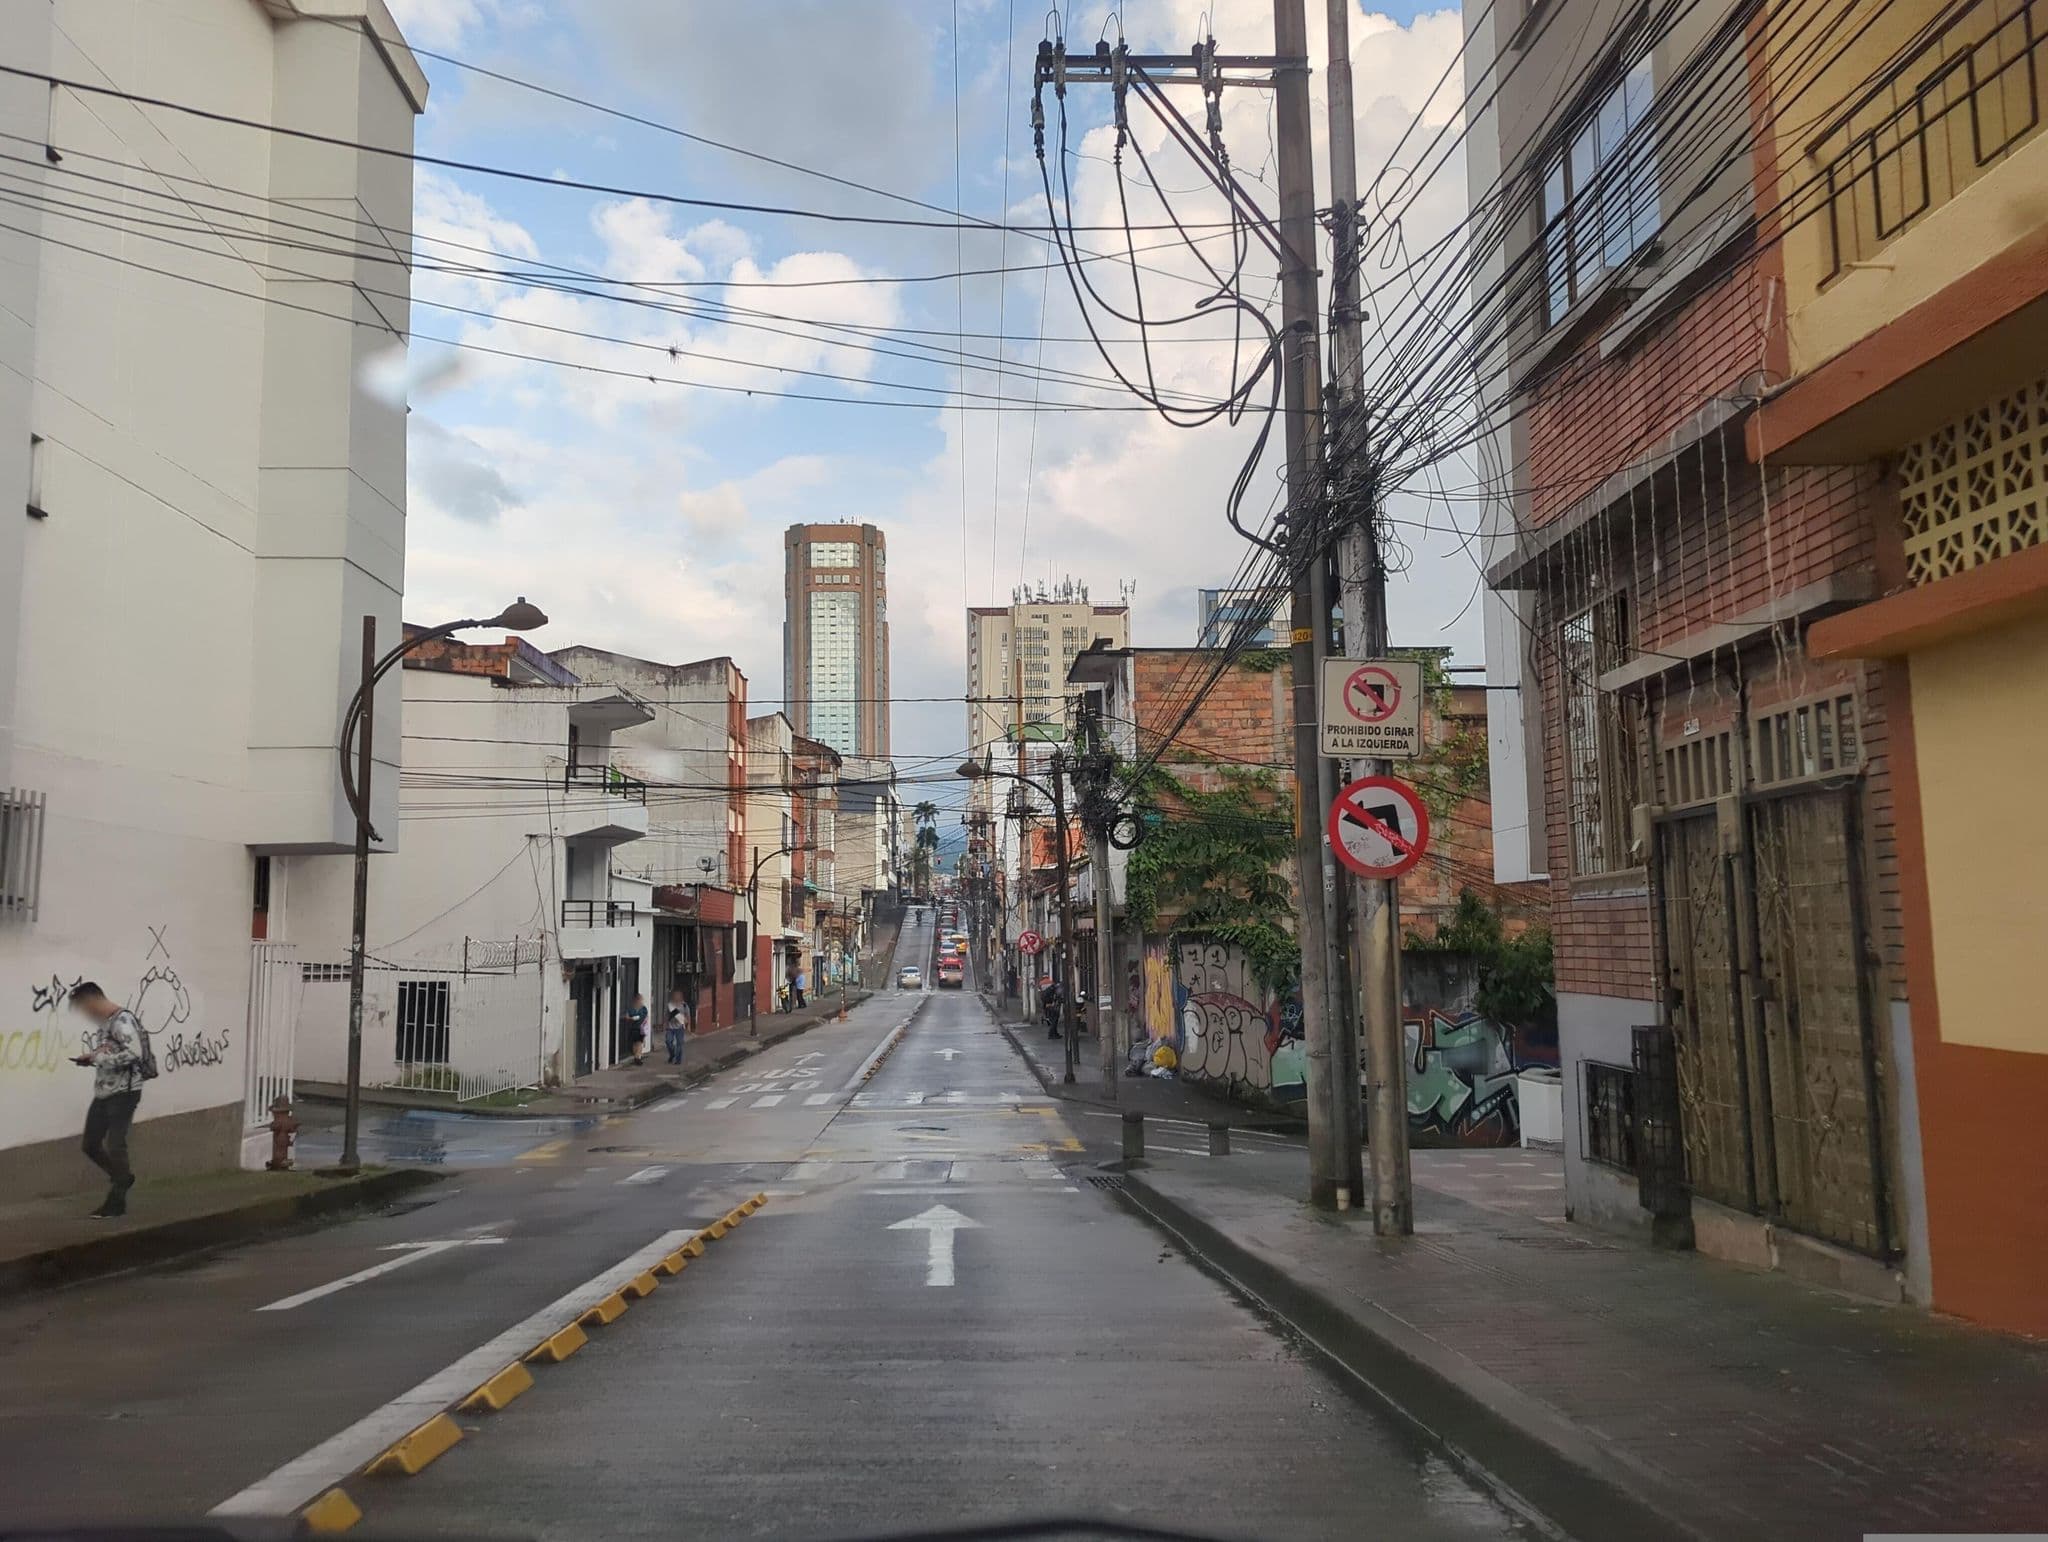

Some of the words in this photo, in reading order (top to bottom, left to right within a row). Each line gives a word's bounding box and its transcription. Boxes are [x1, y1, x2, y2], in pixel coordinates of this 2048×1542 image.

[1327, 725, 1381, 736] PROHIBIDO
[1384, 726, 1414, 737] GIRAR
[1332, 738, 1339, 748] A
[1341, 738, 1354, 748] LA
[1357, 739, 1409, 750] IZQUIERDA
